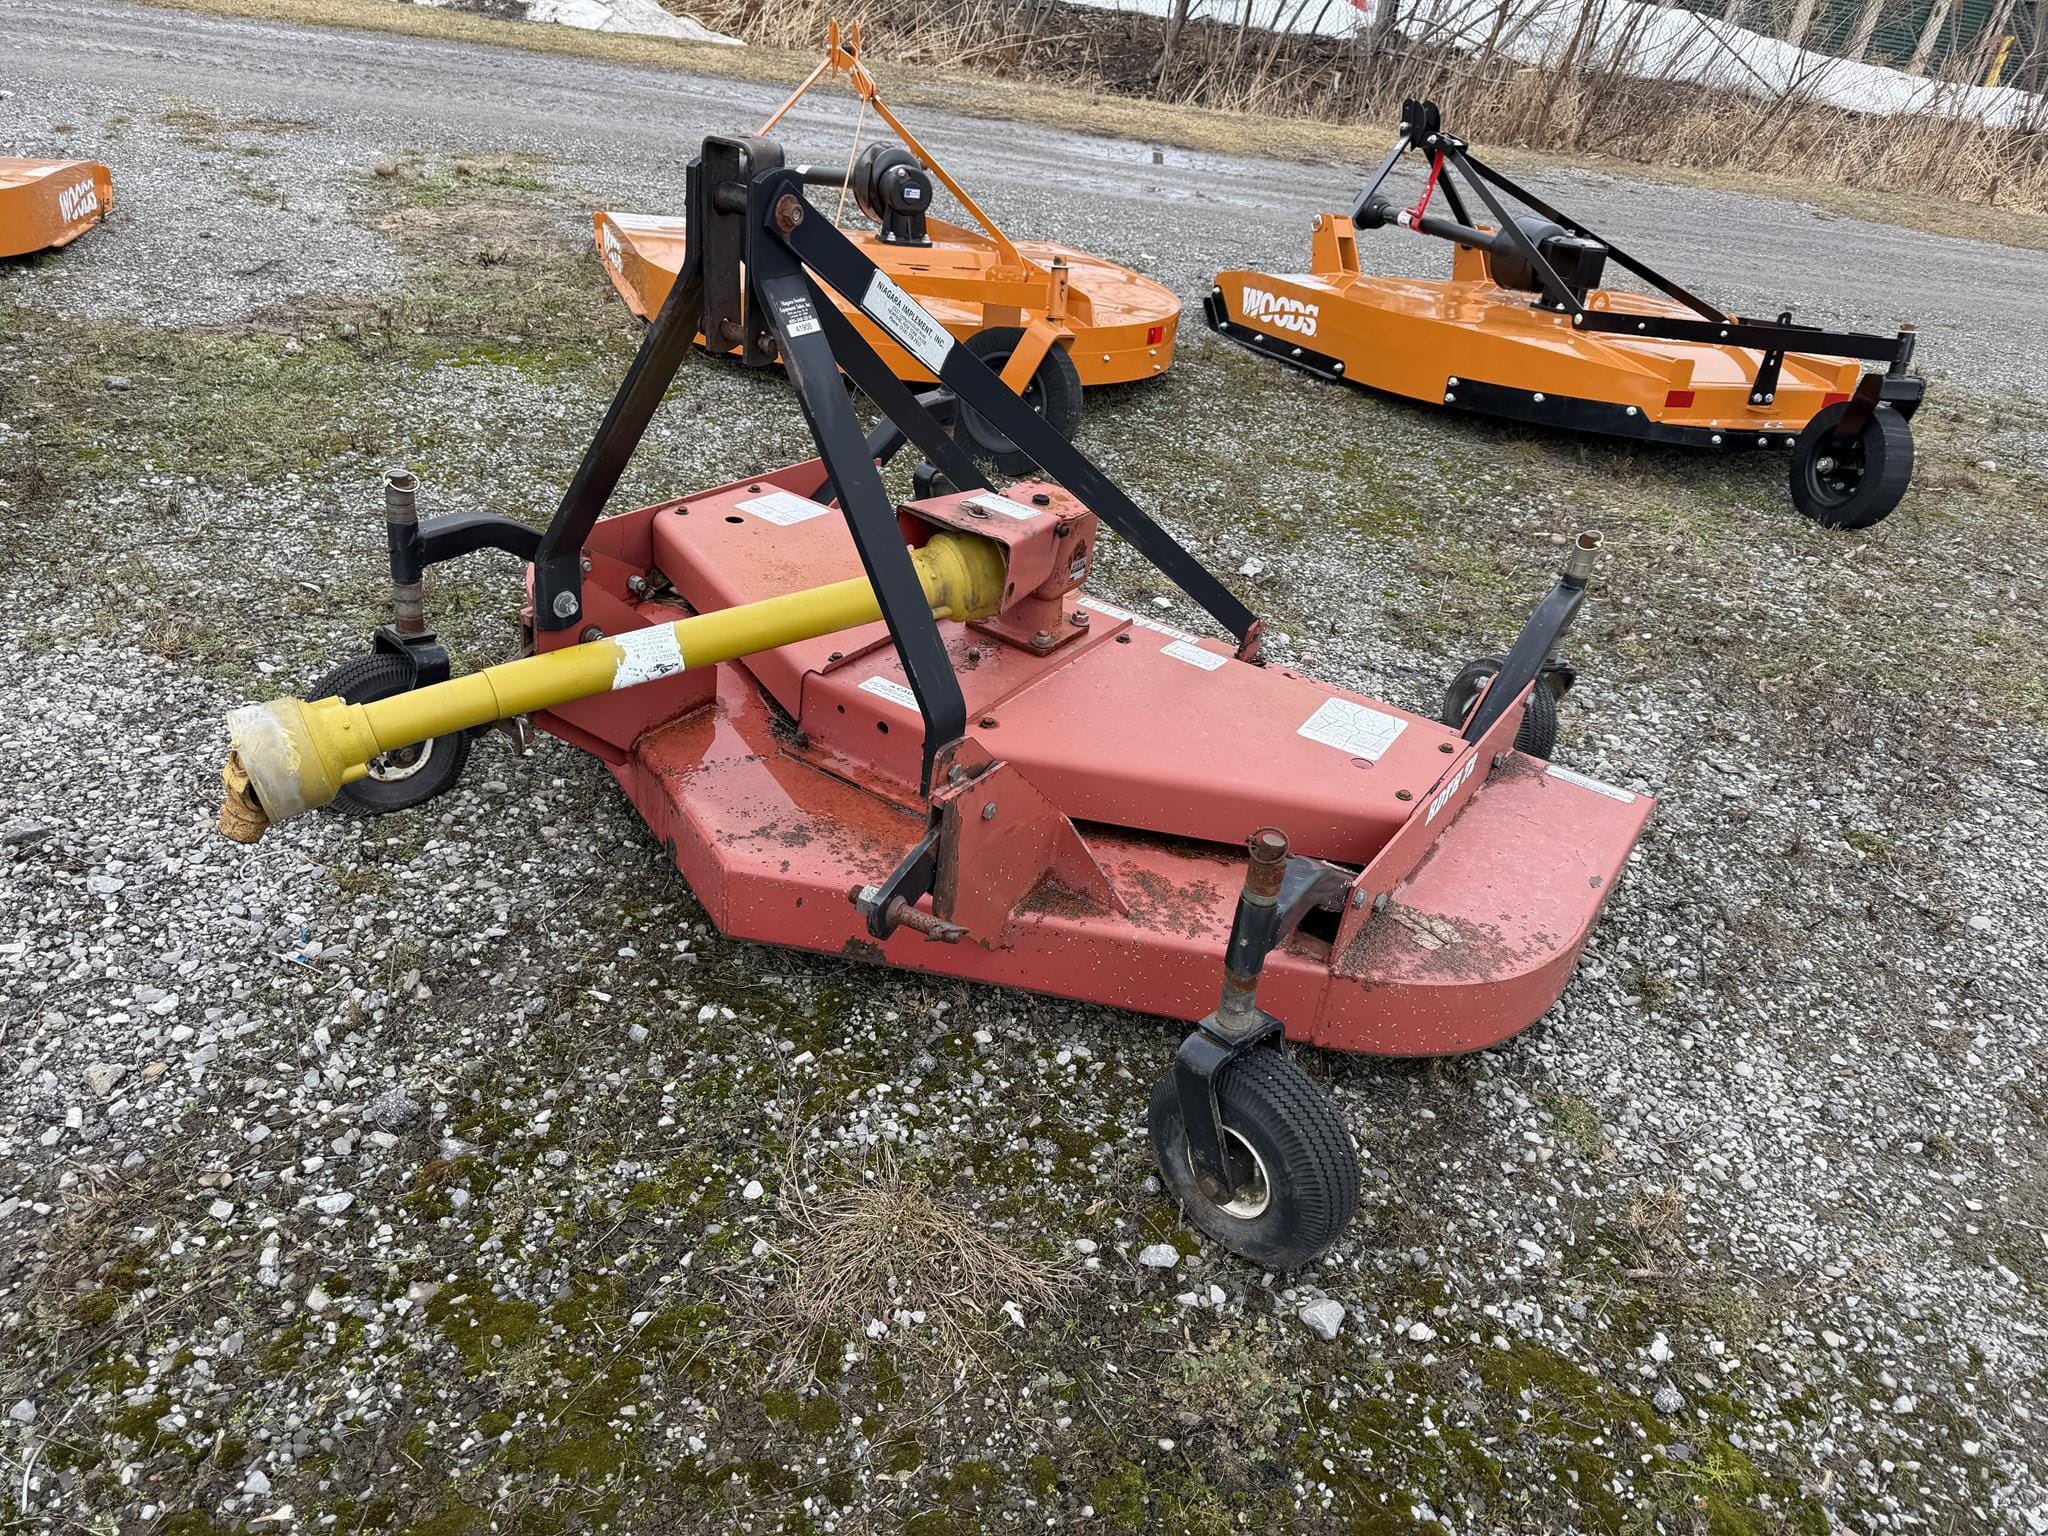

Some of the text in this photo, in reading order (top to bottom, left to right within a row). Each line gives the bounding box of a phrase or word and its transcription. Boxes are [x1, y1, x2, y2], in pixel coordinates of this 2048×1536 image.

[877, 281, 945, 349] NIAGARA IMPLEMENT, INC.
[1243, 286, 1319, 336] WOODS
